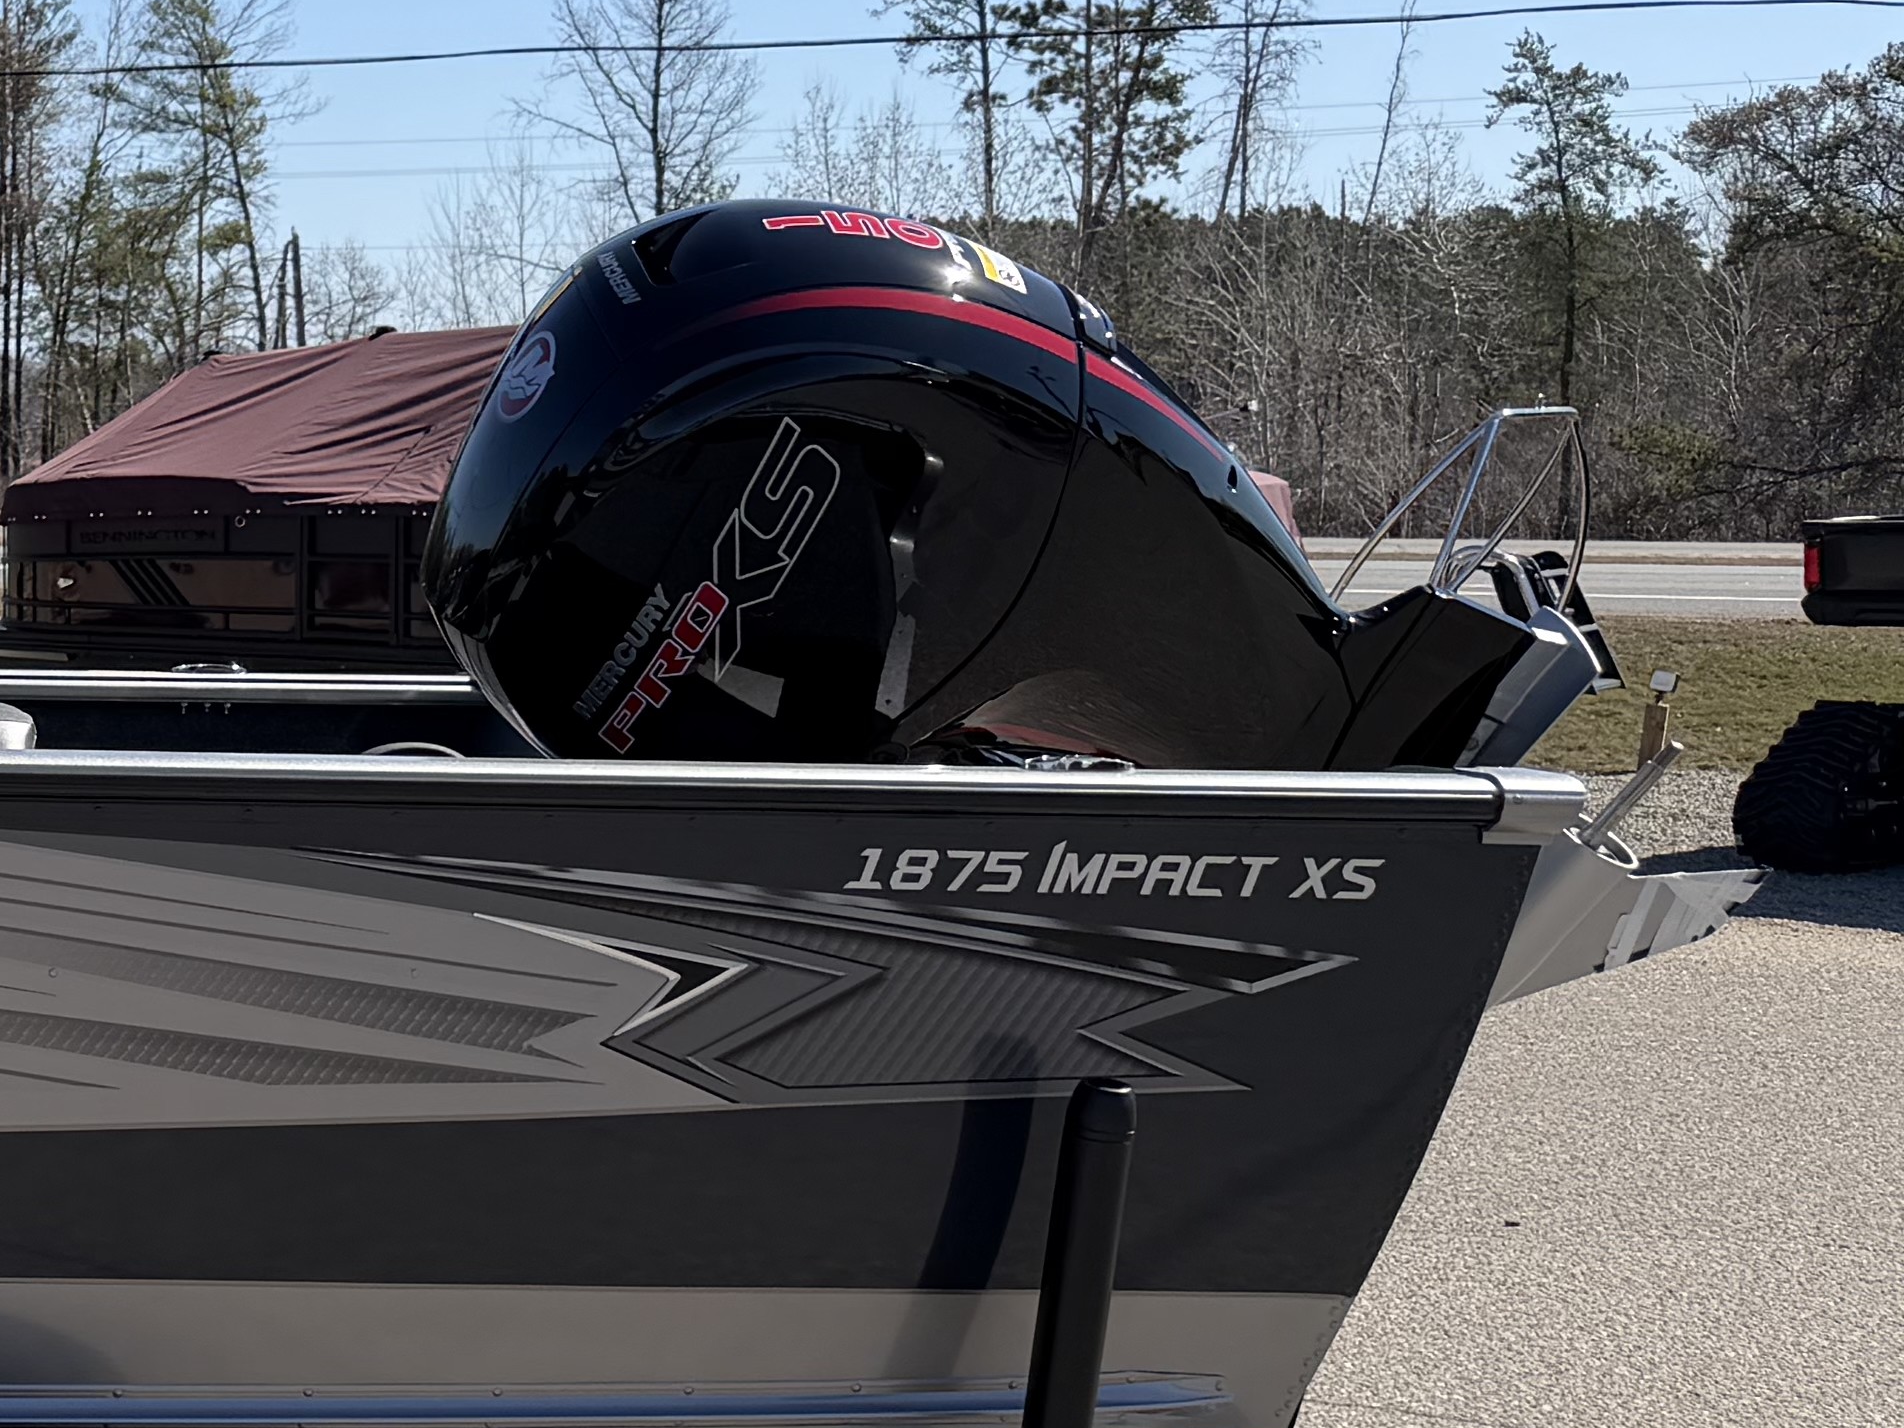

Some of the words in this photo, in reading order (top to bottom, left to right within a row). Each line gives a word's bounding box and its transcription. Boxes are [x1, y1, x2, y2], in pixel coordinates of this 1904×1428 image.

[762, 210, 944, 250] 150
[596, 251, 642, 305] MERCURY
[573, 583, 671, 720] MERCURY
[598, 581, 730, 754] PRO
[843, 847, 1030, 892] 1875
[1036, 839, 1280, 898] IMPACT
[1288, 857, 1386, 901] XS
